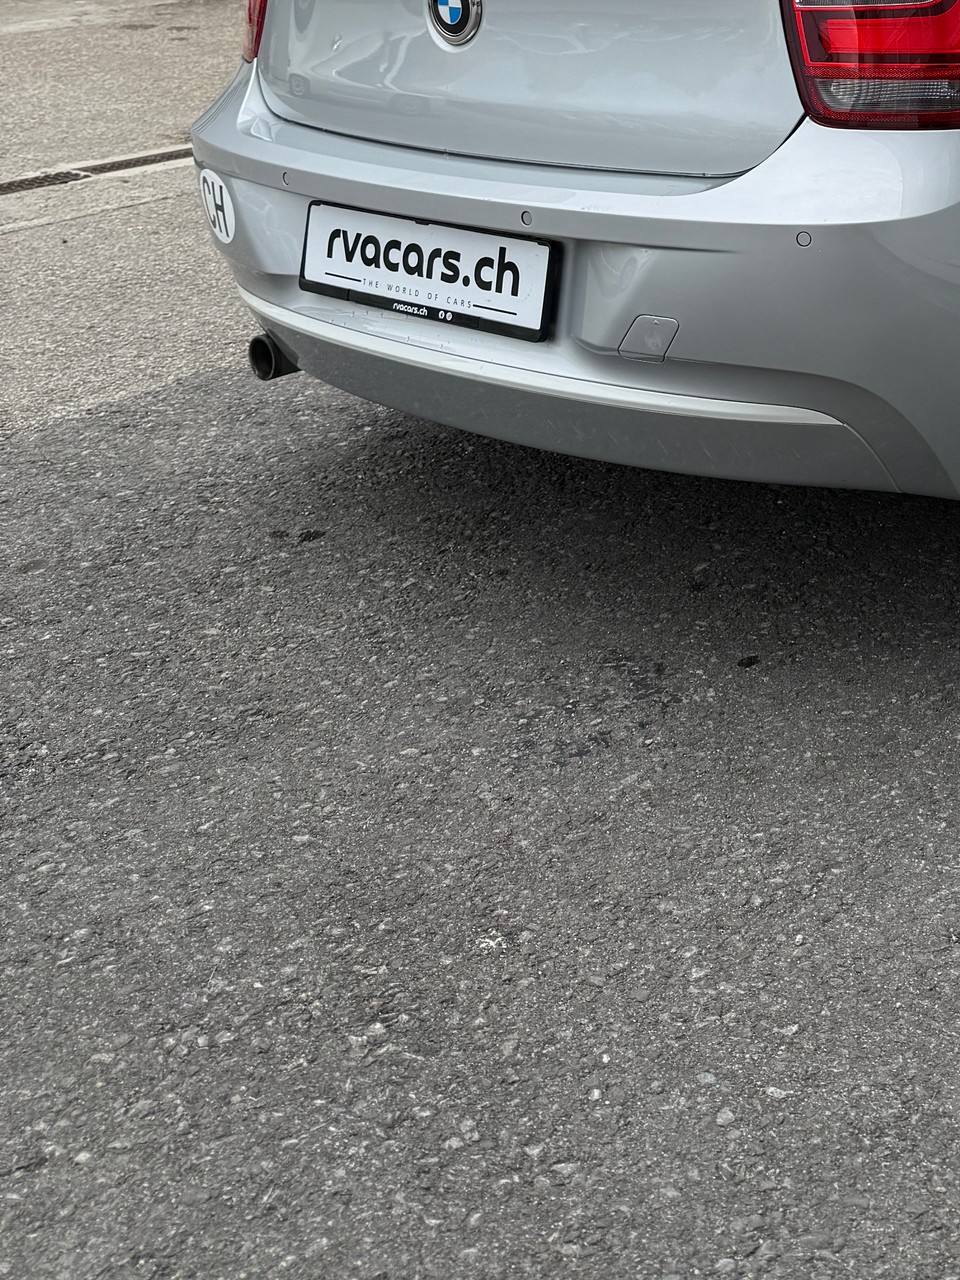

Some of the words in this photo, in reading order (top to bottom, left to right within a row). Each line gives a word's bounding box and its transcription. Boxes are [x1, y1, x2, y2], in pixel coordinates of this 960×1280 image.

[202, 175, 230, 238] CH
[326, 228, 521, 297] rvacars.ch
[362, 278, 380, 289] THE
[387, 283, 420, 297] WORLD
[427, 292, 439, 301] OF
[446, 296, 473, 309] CARS
[392, 302, 428, 317] rvacars.ch
